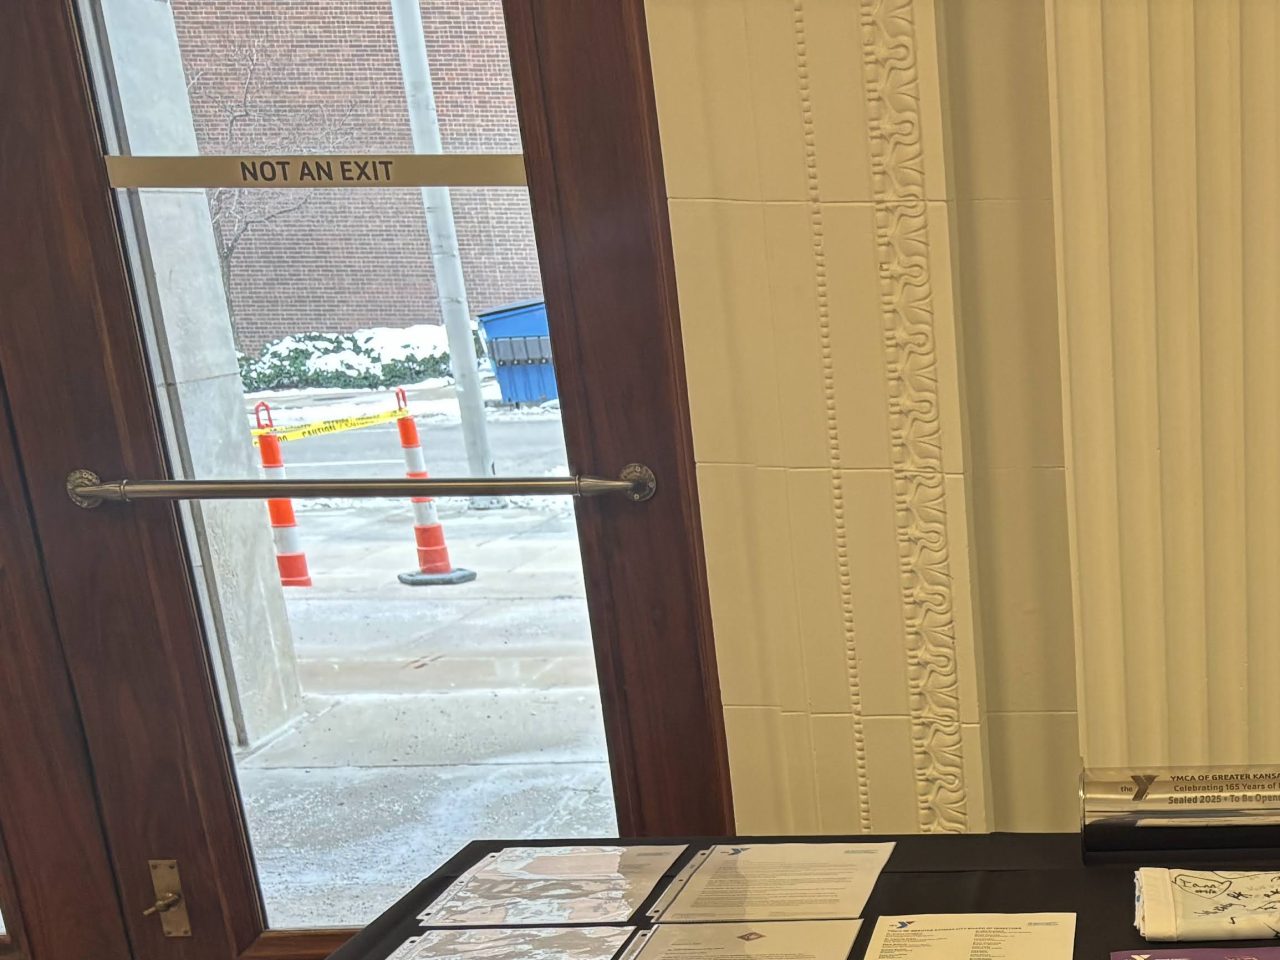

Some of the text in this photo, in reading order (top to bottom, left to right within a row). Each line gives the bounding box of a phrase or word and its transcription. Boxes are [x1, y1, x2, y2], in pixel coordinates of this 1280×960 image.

[240, 160, 393, 182] NOT AN EXIT
[1174, 784, 1224, 792] Celebrating
[1168, 796, 1198, 804] Sealed
[1200, 796, 1222, 804] 2025
